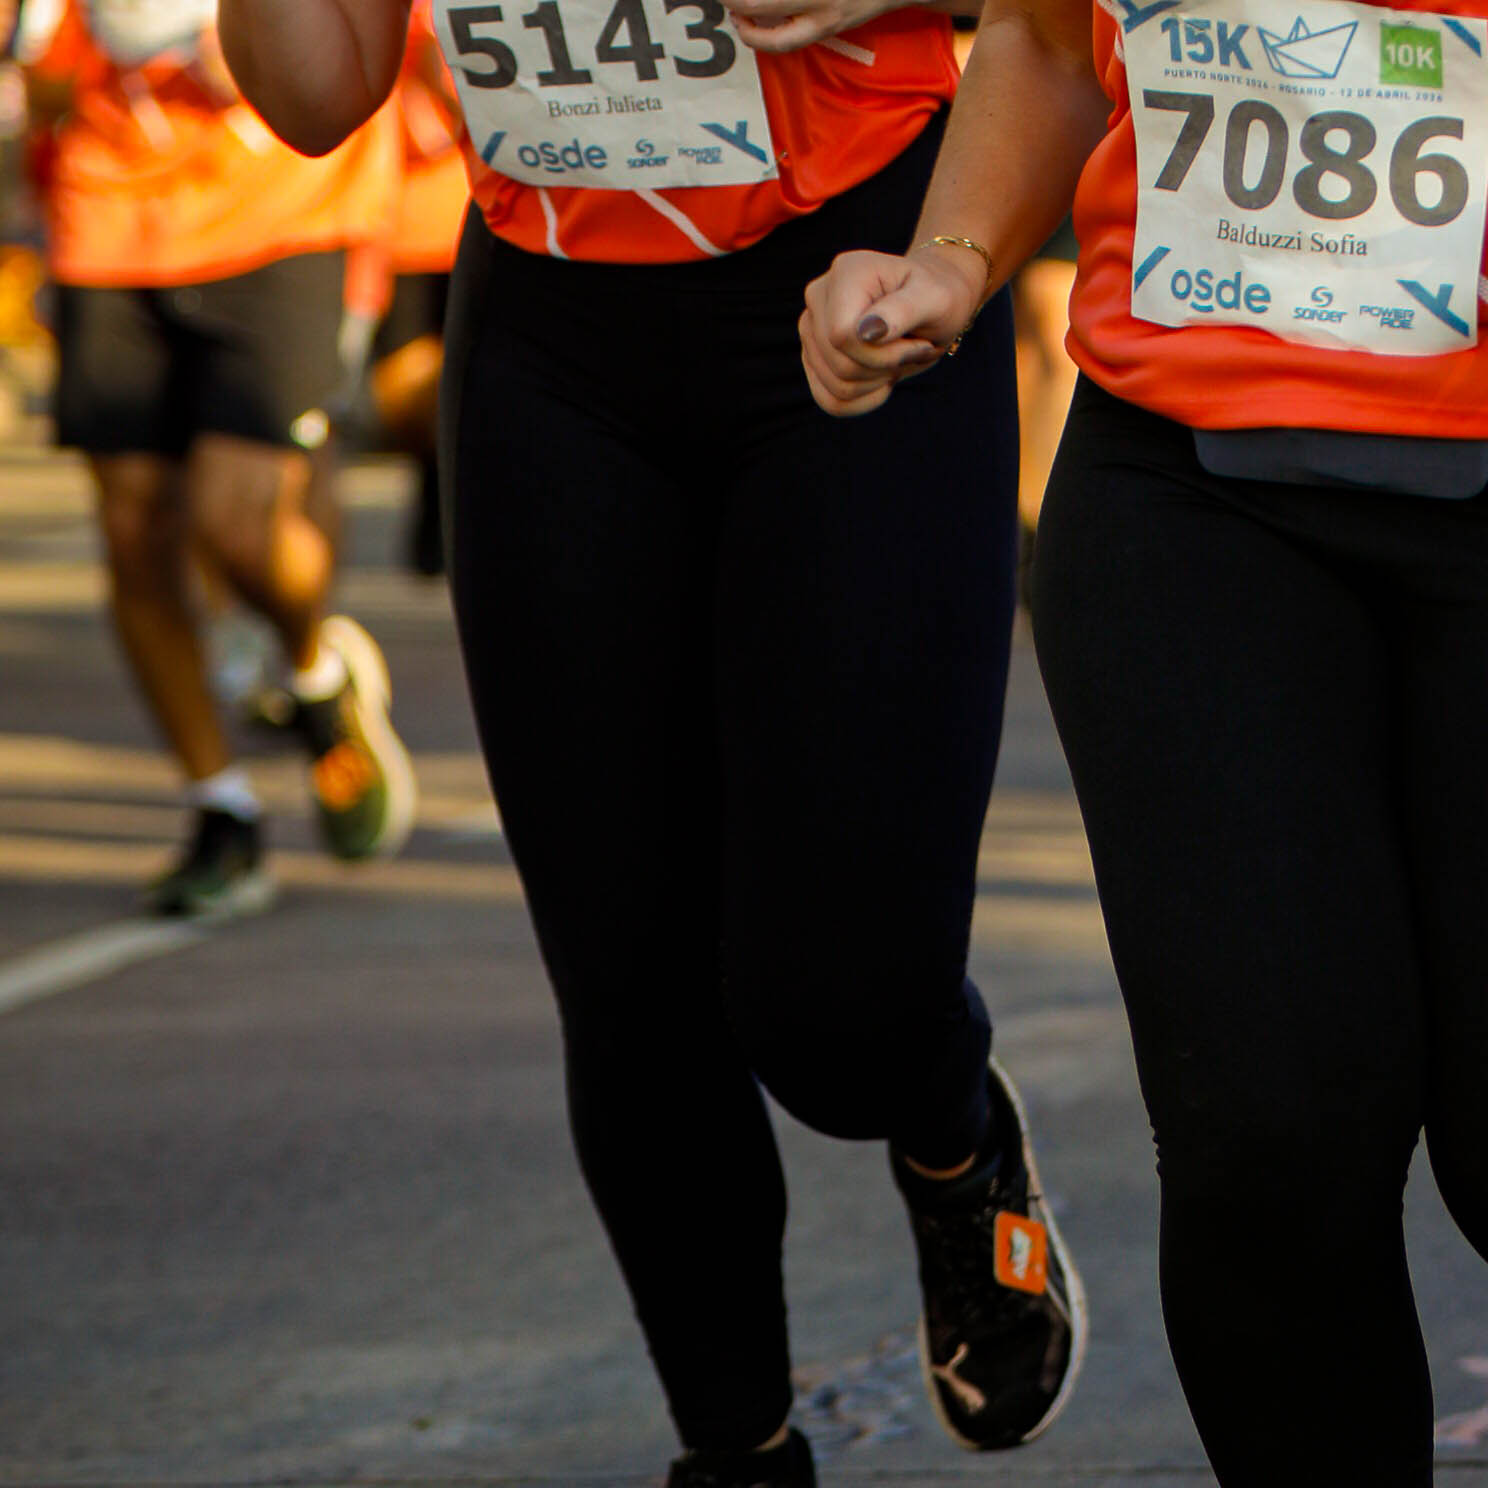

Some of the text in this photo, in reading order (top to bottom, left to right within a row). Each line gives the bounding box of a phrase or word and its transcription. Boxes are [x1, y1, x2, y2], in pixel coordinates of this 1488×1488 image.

[1160, 17, 1253, 71] 15K
[1385, 42, 1437, 71] 10K
[547, 94, 664, 118] Bonzi Julieta
[517, 138, 608, 172] osde
[1142, 88, 1469, 228] 7086
[1217, 218, 1368, 256] Balduzzi Sofia
[1170, 269, 1271, 313] osde
